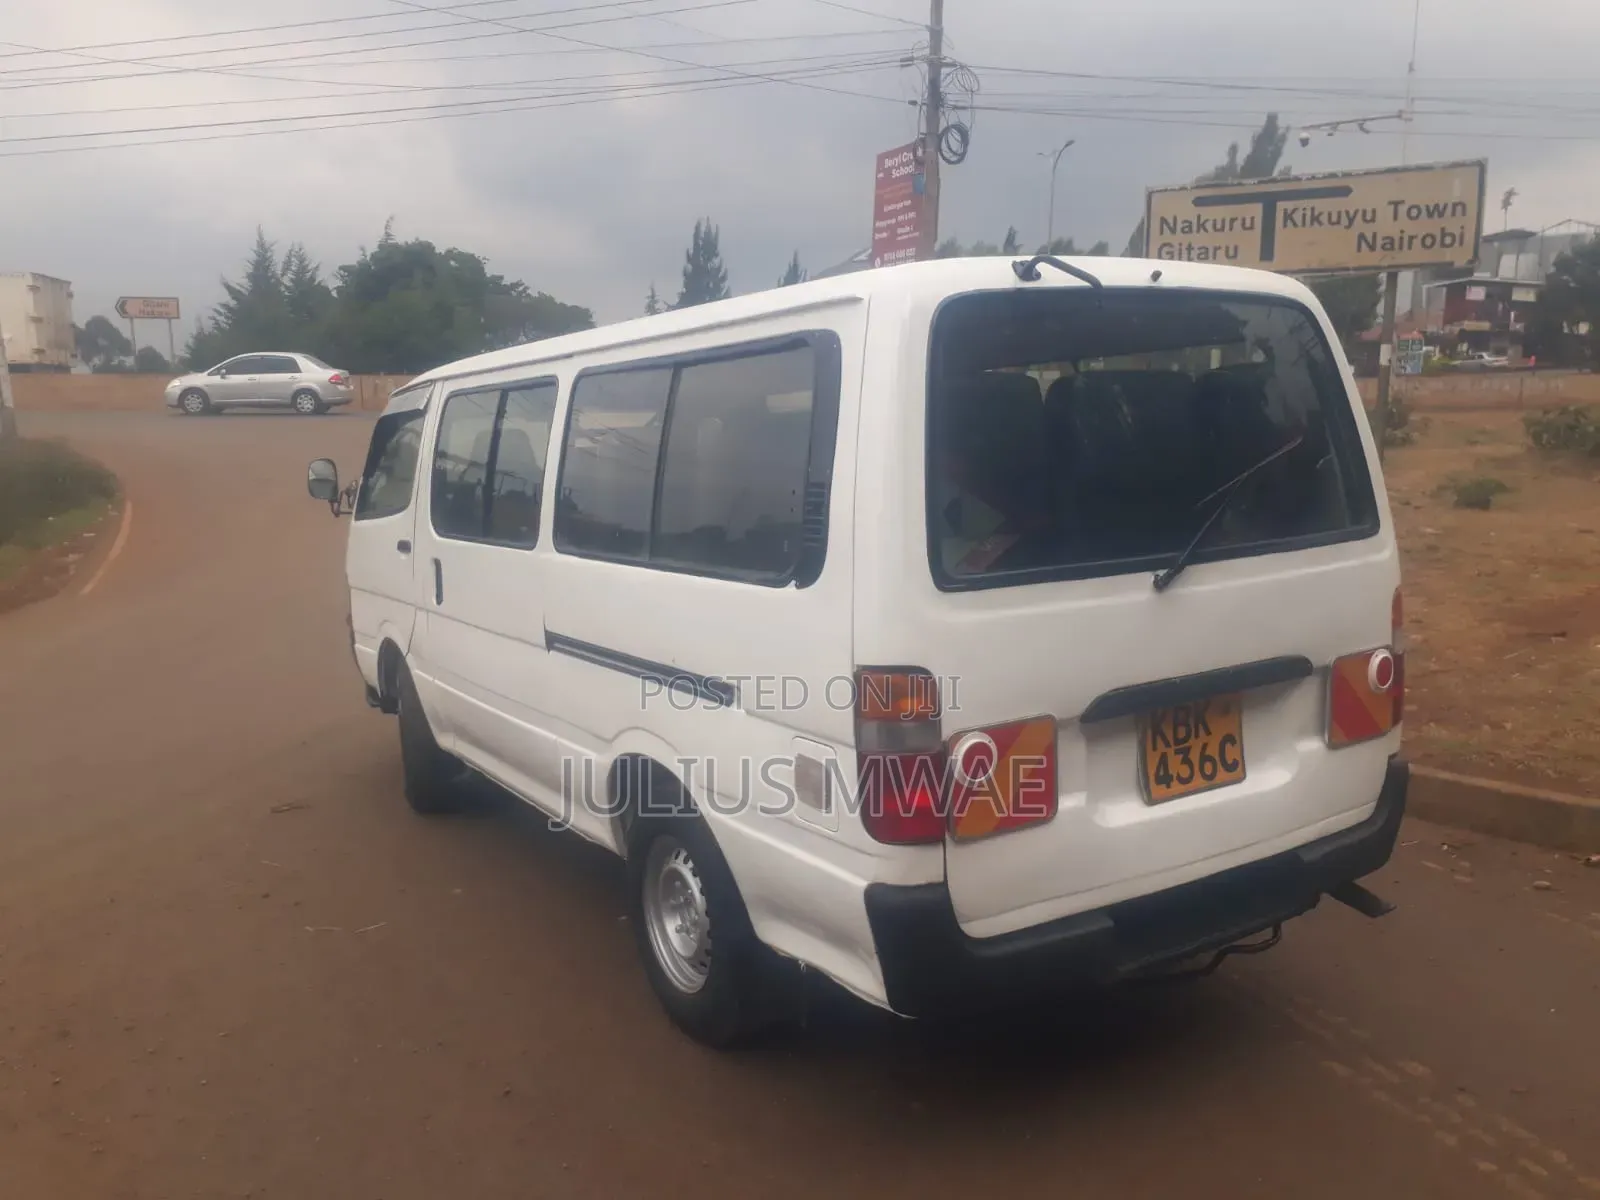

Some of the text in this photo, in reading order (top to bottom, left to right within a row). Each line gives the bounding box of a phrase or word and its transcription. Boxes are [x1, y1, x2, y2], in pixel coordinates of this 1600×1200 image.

[892, 162, 915, 178] School
[1158, 212, 1256, 236] Nakuru
[1281, 199, 1468, 230] Kikuyu Town
[1157, 242, 1239, 262] Gitaru
[1356, 226, 1466, 253] Nairobi
[1150, 699, 1212, 751] KBK
[1154, 733, 1240, 789] 436C
